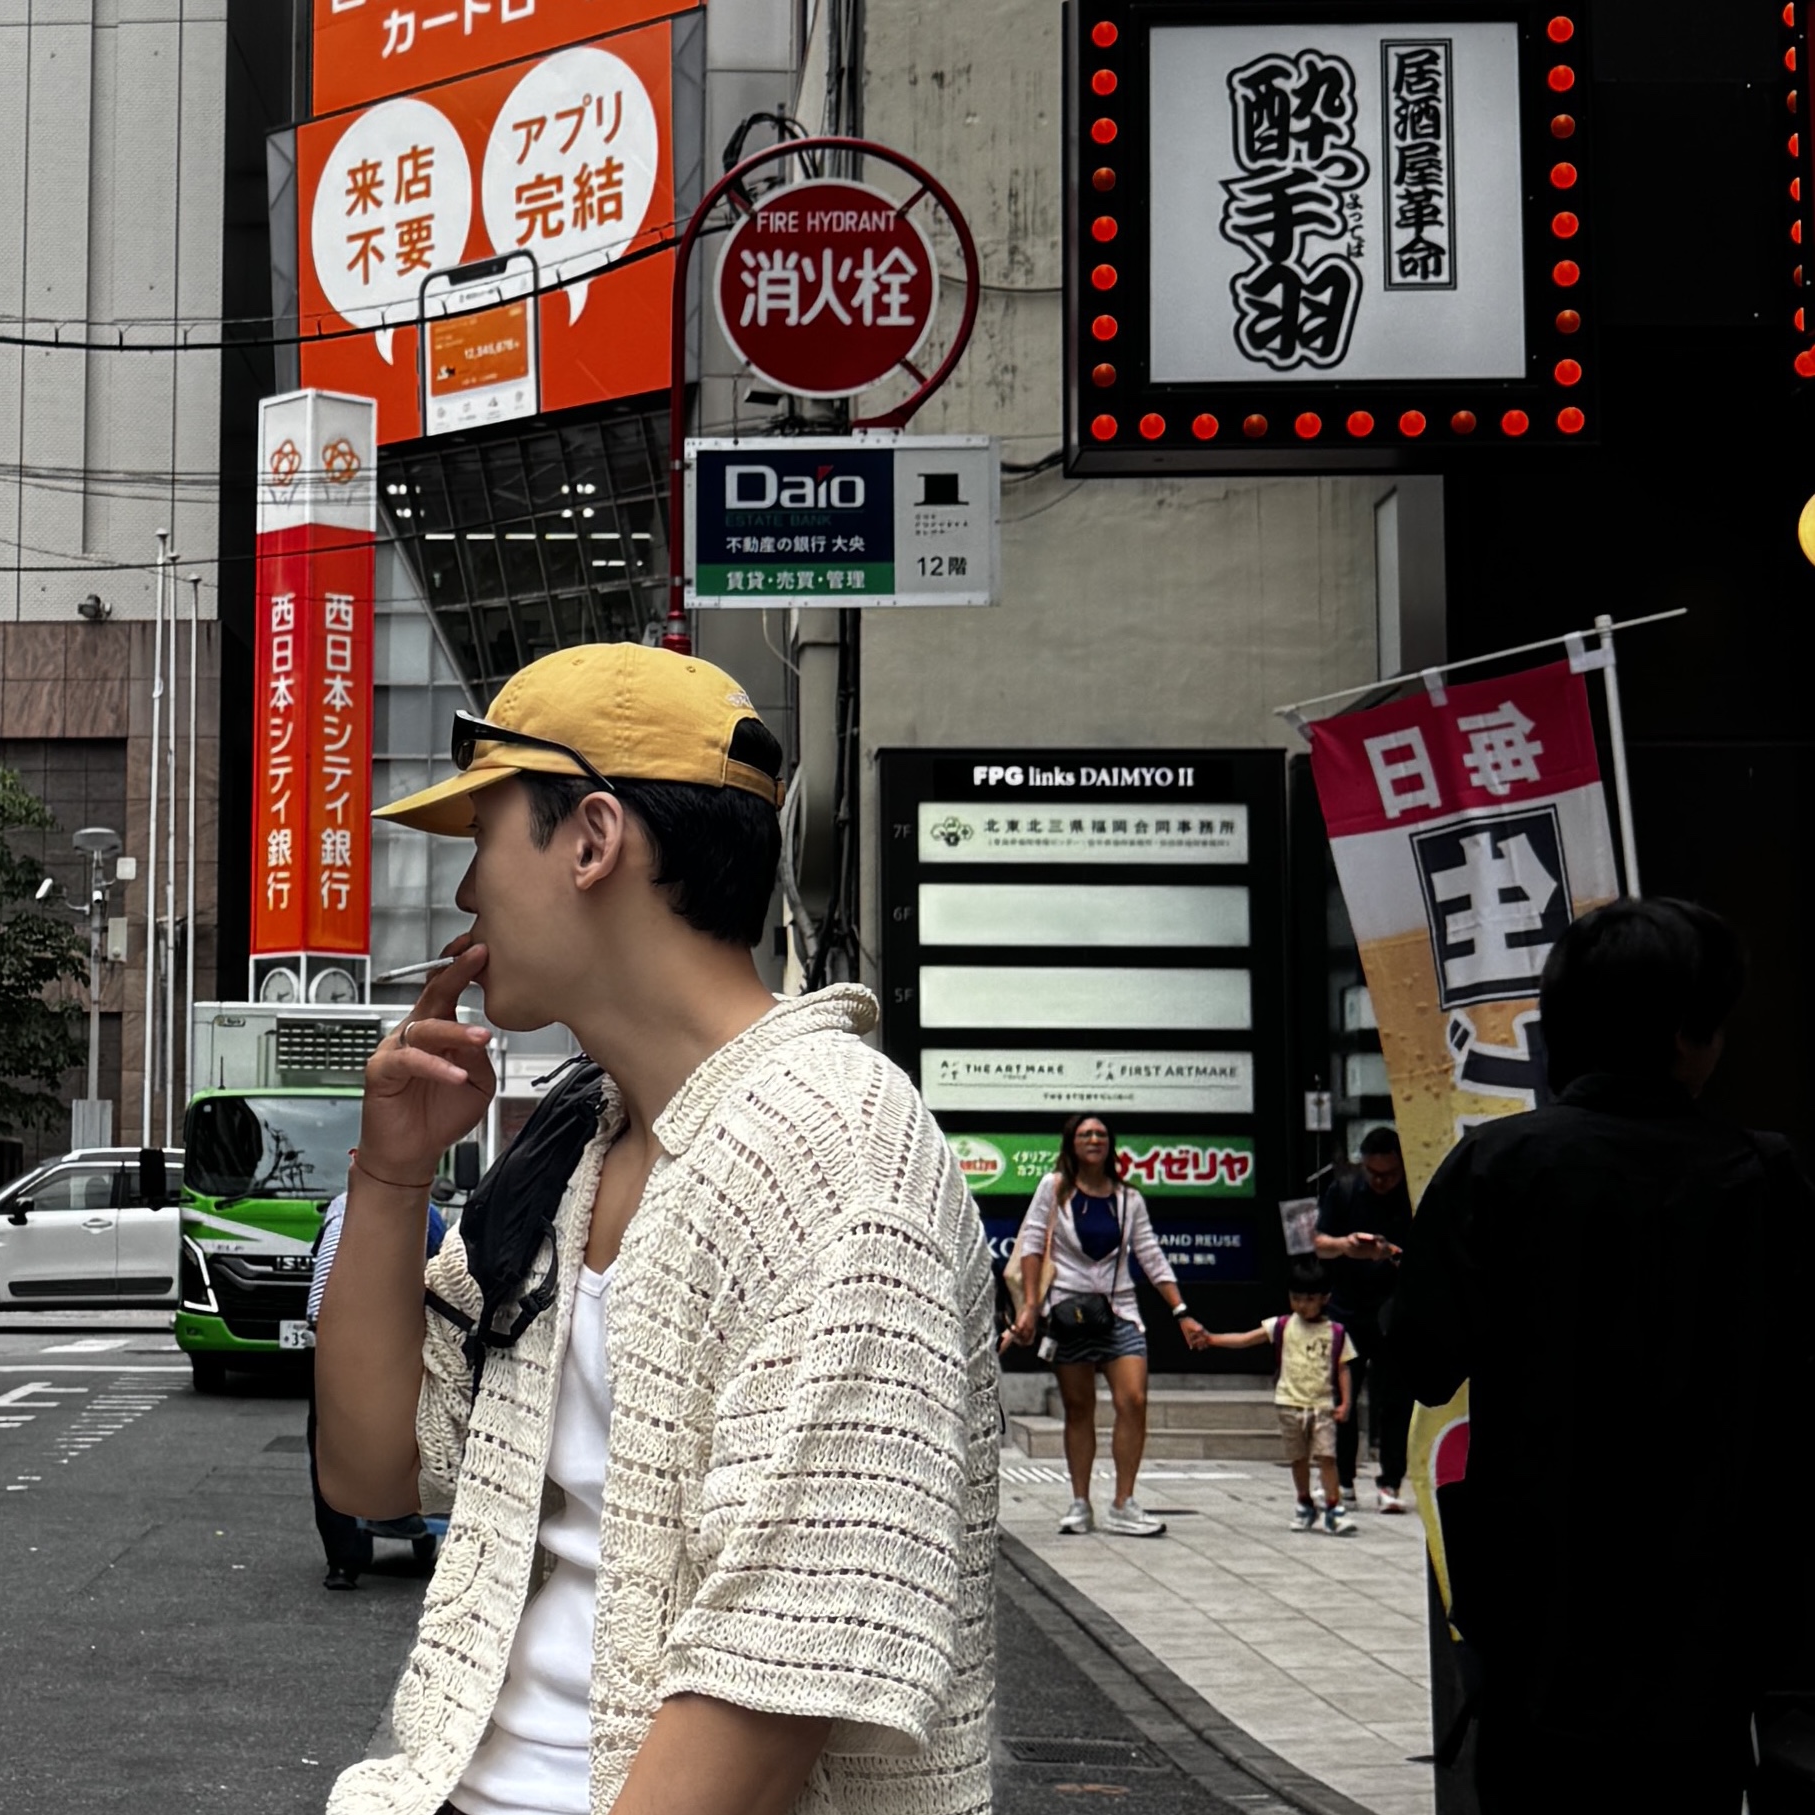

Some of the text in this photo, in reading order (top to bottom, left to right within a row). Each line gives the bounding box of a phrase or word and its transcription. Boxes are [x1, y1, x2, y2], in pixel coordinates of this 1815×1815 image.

[512, 90, 624, 165] アプリ
[1393, 49, 1446, 281] 居酒屋革命
[345, 145, 435, 217] 来店
[514, 157, 624, 247] 完結
[756, 210, 897, 233] FIRE HYDRANT
[346, 213, 435, 285] 不要
[739, 246, 918, 328] 消火栓
[726, 535, 866, 553] 不動産の銀行 大央
[917, 556, 967, 577] 12階
[726, 570, 866, 591] 賃貸・売買・管理
[266, 591, 296, 912] 西日本シティ銀行
[320, 591, 354, 912] 西日本シティ銀行
[973, 766, 1024, 787] FPG
[1028, 766, 1075, 787] links
[1080, 767, 1174, 788] DAIMYO
[893, 824, 911, 840] 7F
[893, 907, 911, 923] 6F
[894, 988, 913, 1004] 5F
[1194, 1234, 1242, 1248] REUSE
[276, 1257, 317, 1270] ISU
